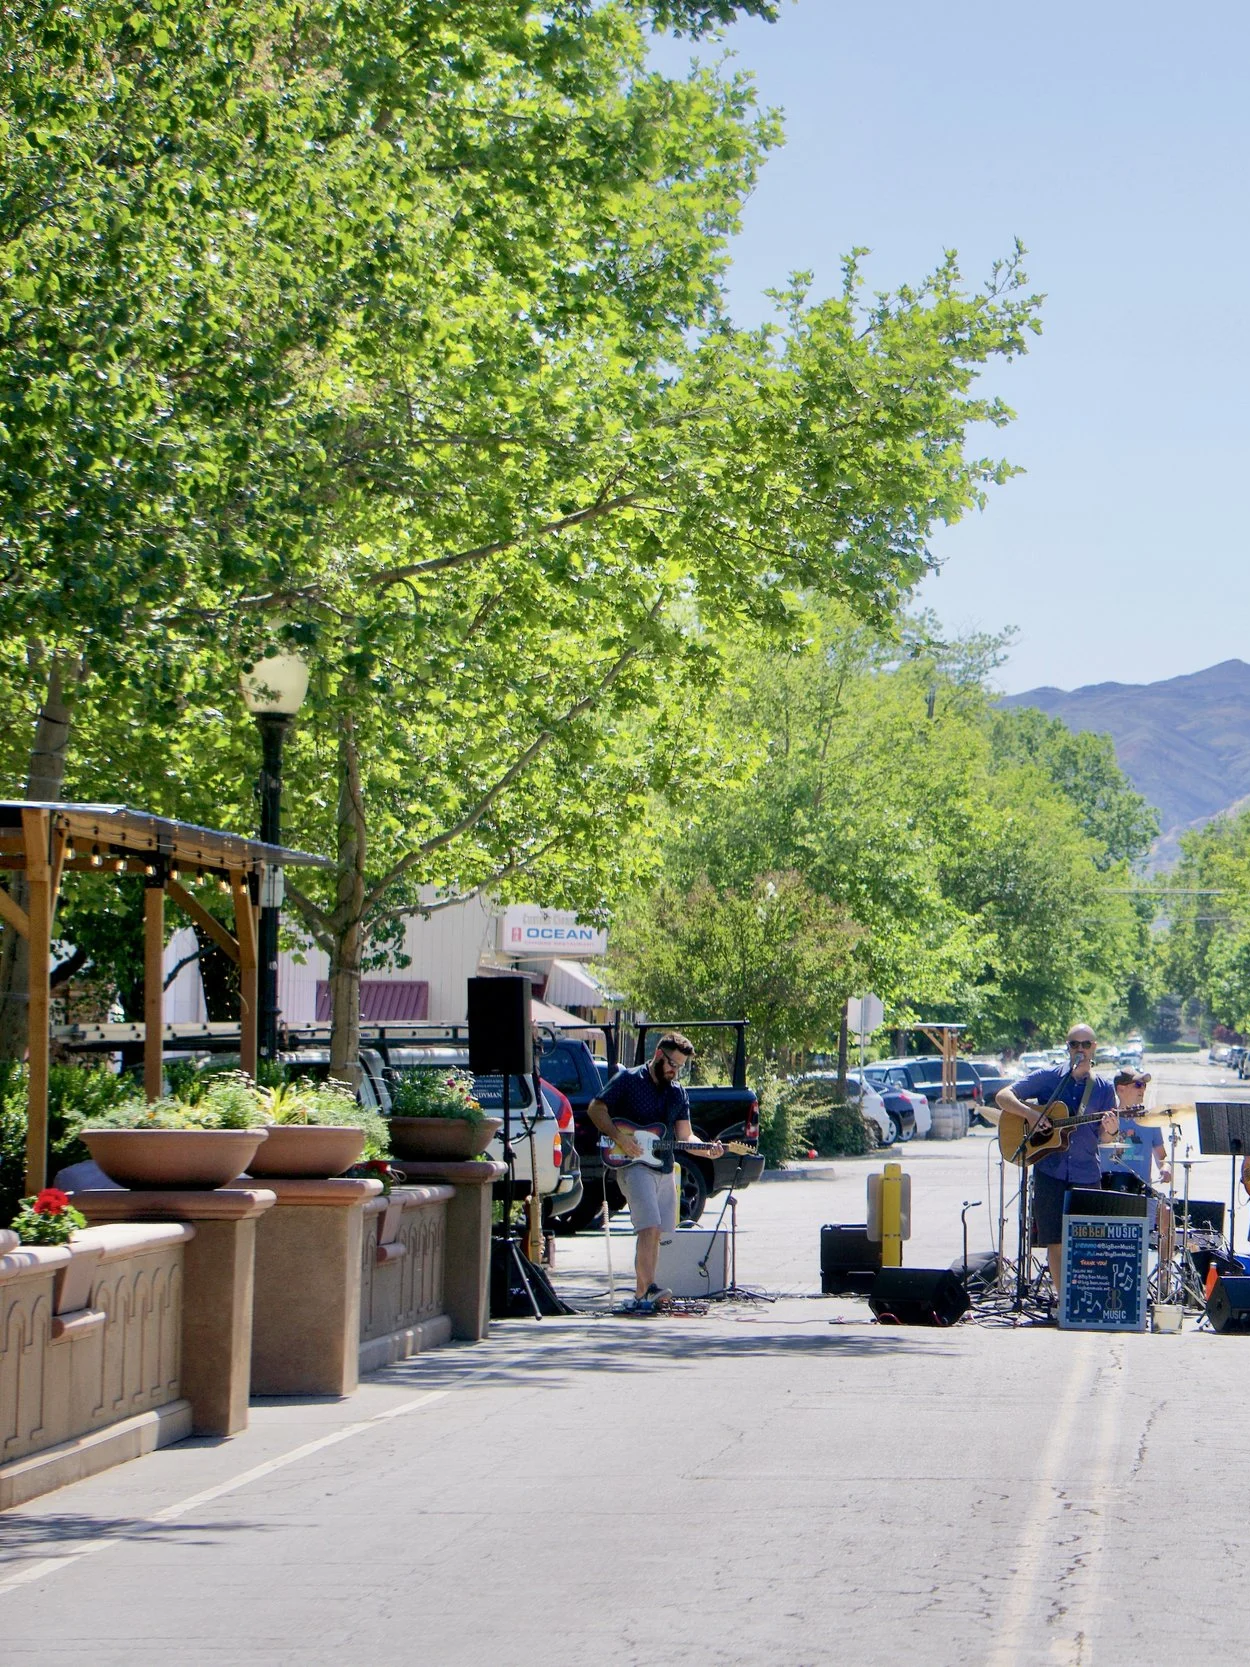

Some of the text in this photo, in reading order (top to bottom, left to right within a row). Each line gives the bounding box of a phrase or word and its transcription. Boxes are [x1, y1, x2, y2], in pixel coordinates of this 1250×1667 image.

[526, 927, 593, 940] OCEAN
[1072, 1226, 1138, 1239] BIG BEN MUSIC
[1103, 1310, 1127, 1320] MUSIC
